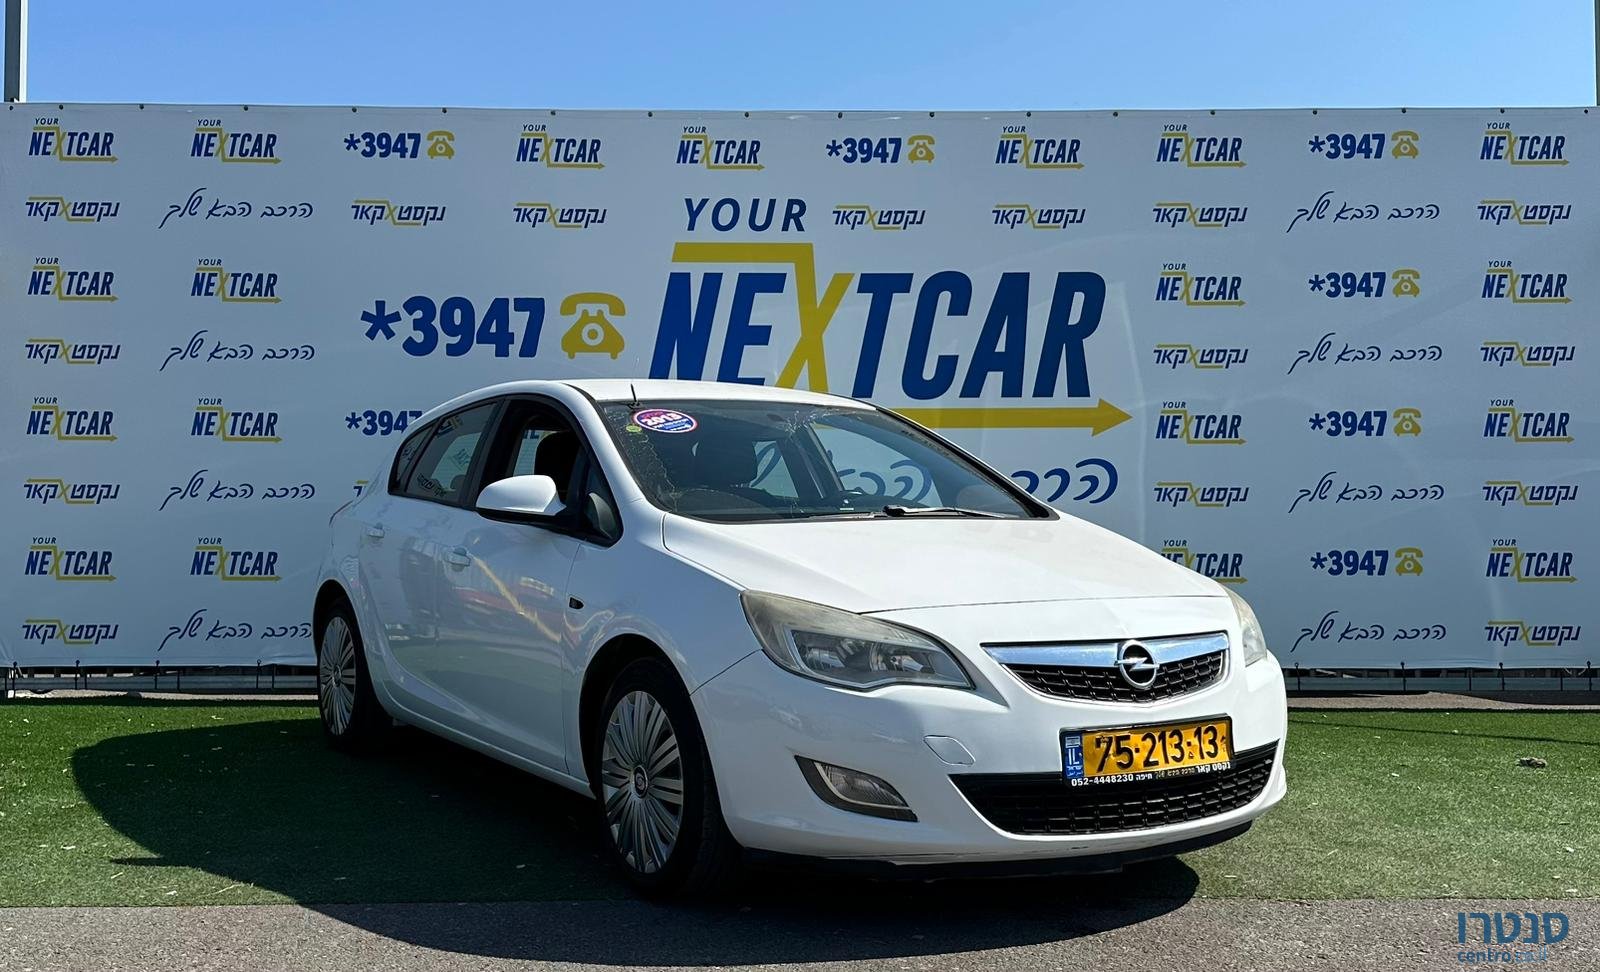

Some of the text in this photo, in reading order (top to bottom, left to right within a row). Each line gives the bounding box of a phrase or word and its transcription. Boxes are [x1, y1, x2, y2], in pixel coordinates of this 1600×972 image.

[35, 117, 59, 125] YOUR
[1002, 125, 1026, 133] YOUR
[1163, 123, 1188, 131] YOUR
[29, 132, 113, 156] NEXTCAR
[191, 134, 276, 157] NEXTCAR
[517, 138, 600, 162] NEXTCAR
[677, 141, 760, 164] NEXTCAR
[996, 140, 1080, 163] NEXTCAR
[1157, 138, 1242, 161] NEXTCAR
[1481, 136, 1565, 159] NEXTCAR
[685, 198, 806, 231] YOUR
[1162, 262, 1187, 270] YOUR
[28, 272, 113, 295] NEXTCAR
[191, 273, 277, 297] NEXTCAR
[1156, 277, 1241, 300] NEXTCAR
[1482, 274, 1567, 298] NEXTCAR
[649, 270, 1105, 399] NEXTCAR
[33, 396, 58, 404] YOUR
[198, 397, 223, 405] YOUR
[1490, 398, 1514, 406] YOUR
[27, 411, 113, 435] NEXTCAR
[191, 412, 277, 436] NEXTCAR
[1156, 415, 1241, 438] NEXTCAR
[1484, 413, 1569, 436] NEXTCAR
[32, 536, 57, 544] YOUR
[1492, 538, 1517, 546] YOUR
[25, 551, 112, 575] NEXTCAR
[191, 552, 277, 575] NEXTCAR
[1486, 553, 1572, 576] NEXTCAR
